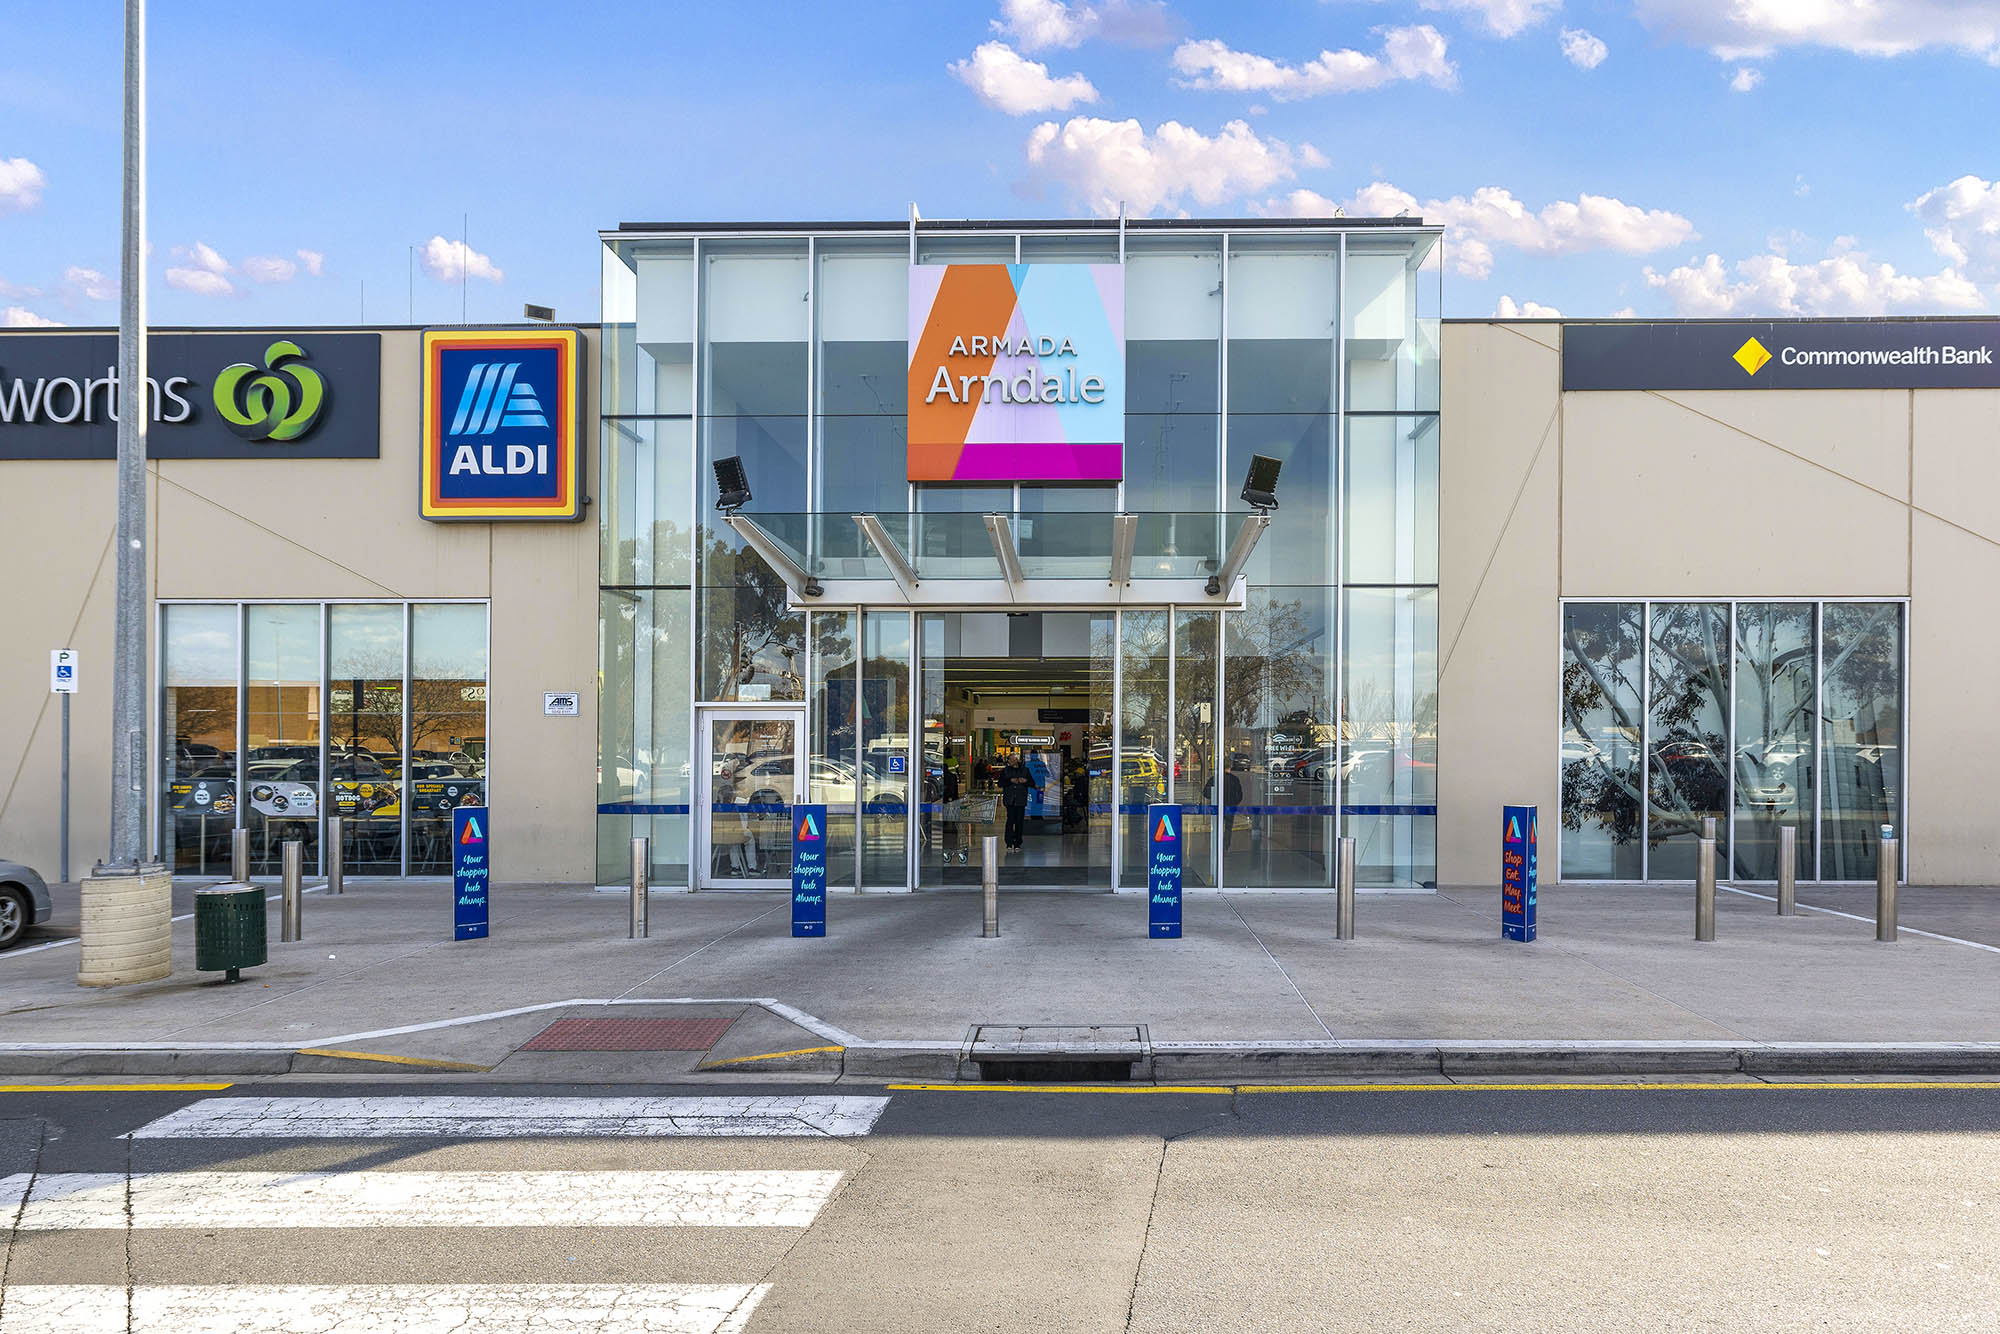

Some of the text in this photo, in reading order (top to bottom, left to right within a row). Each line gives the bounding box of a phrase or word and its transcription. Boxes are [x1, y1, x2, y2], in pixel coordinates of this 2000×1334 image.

[949, 335, 1078, 357] ARMADA
[925, 365, 1105, 404] Arndale
[449, 445, 548, 474] ALDI
[549, 697, 574, 706] AMS
[463, 855, 483, 865] Your
[799, 851, 819, 862] Your
[1156, 852, 1176, 862] Your
[456, 867, 488, 879] shopping
[794, 864, 825, 877] shopping
[1150, 864, 1181, 878] shopping
